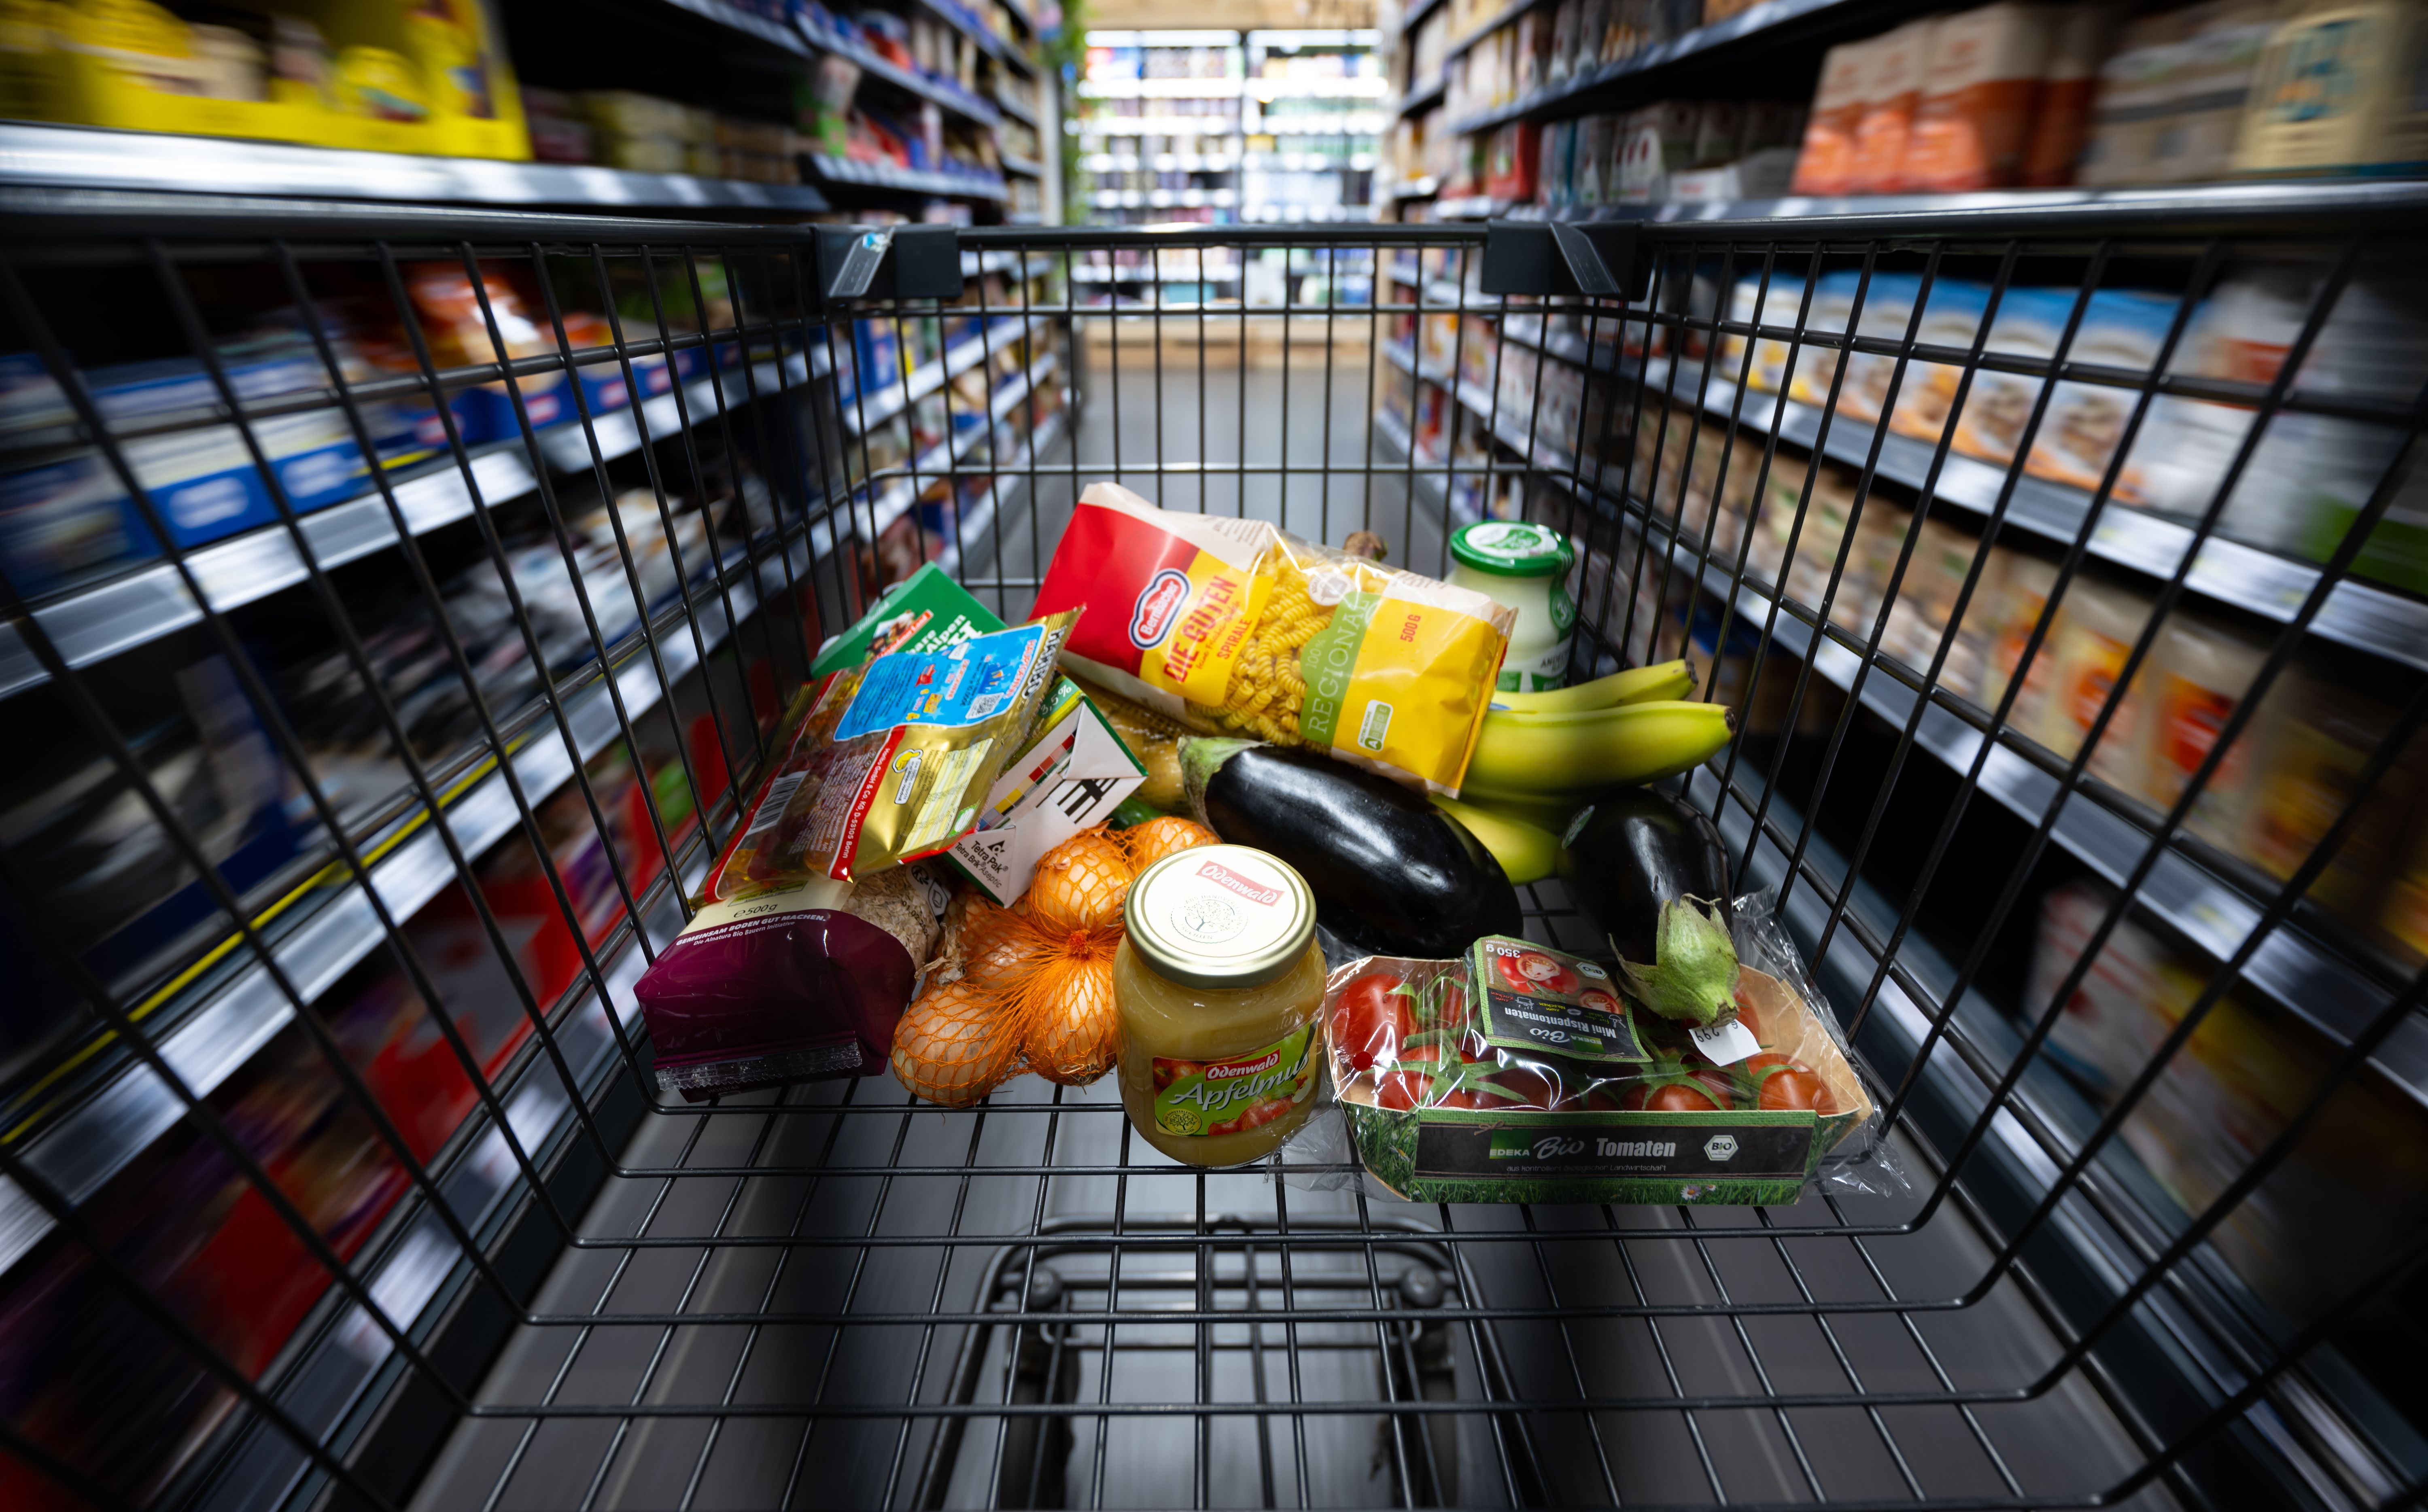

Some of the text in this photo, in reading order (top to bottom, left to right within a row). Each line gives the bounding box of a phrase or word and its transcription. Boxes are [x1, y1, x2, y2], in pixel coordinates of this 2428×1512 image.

[1140, 581, 1179, 636] Bernbacher
[1163, 641, 1199, 683] DIE
[1181, 575, 1238, 644] GUTEN
[1216, 618, 1252, 660] SPIRALE
[1400, 621, 1419, 642] 500
[1307, 599, 1371, 736] REGIONAL
[843, 840, 852, 859] Bonn
[955, 842, 969, 858] Tetra
[979, 865, 1002, 888] Aseptic
[971, 840, 989, 861] Tetra
[1201, 865, 1278, 903] Odenwald
[675, 927, 729, 946] GEMEINSAM
[728, 920, 760, 932] BODEN
[781, 913, 826, 922] MACHEN.
[705, 933, 731, 943] Alnatura
[745, 926, 766, 936] Bauern
[767, 921, 795, 930] Initiative
[1486, 943, 1520, 959] 350 g
[1505, 1006, 1617, 1039] Mini Rispentomaten
[1530, 1028, 1602, 1045] EDEKA Bio
[1168, 1052, 1310, 1112] Apfelmus
[1207, 1053, 1279, 1079] Odenwald
[1533, 1137, 1585, 1160] Bio
[1596, 1138, 1676, 1157] Tomaten
